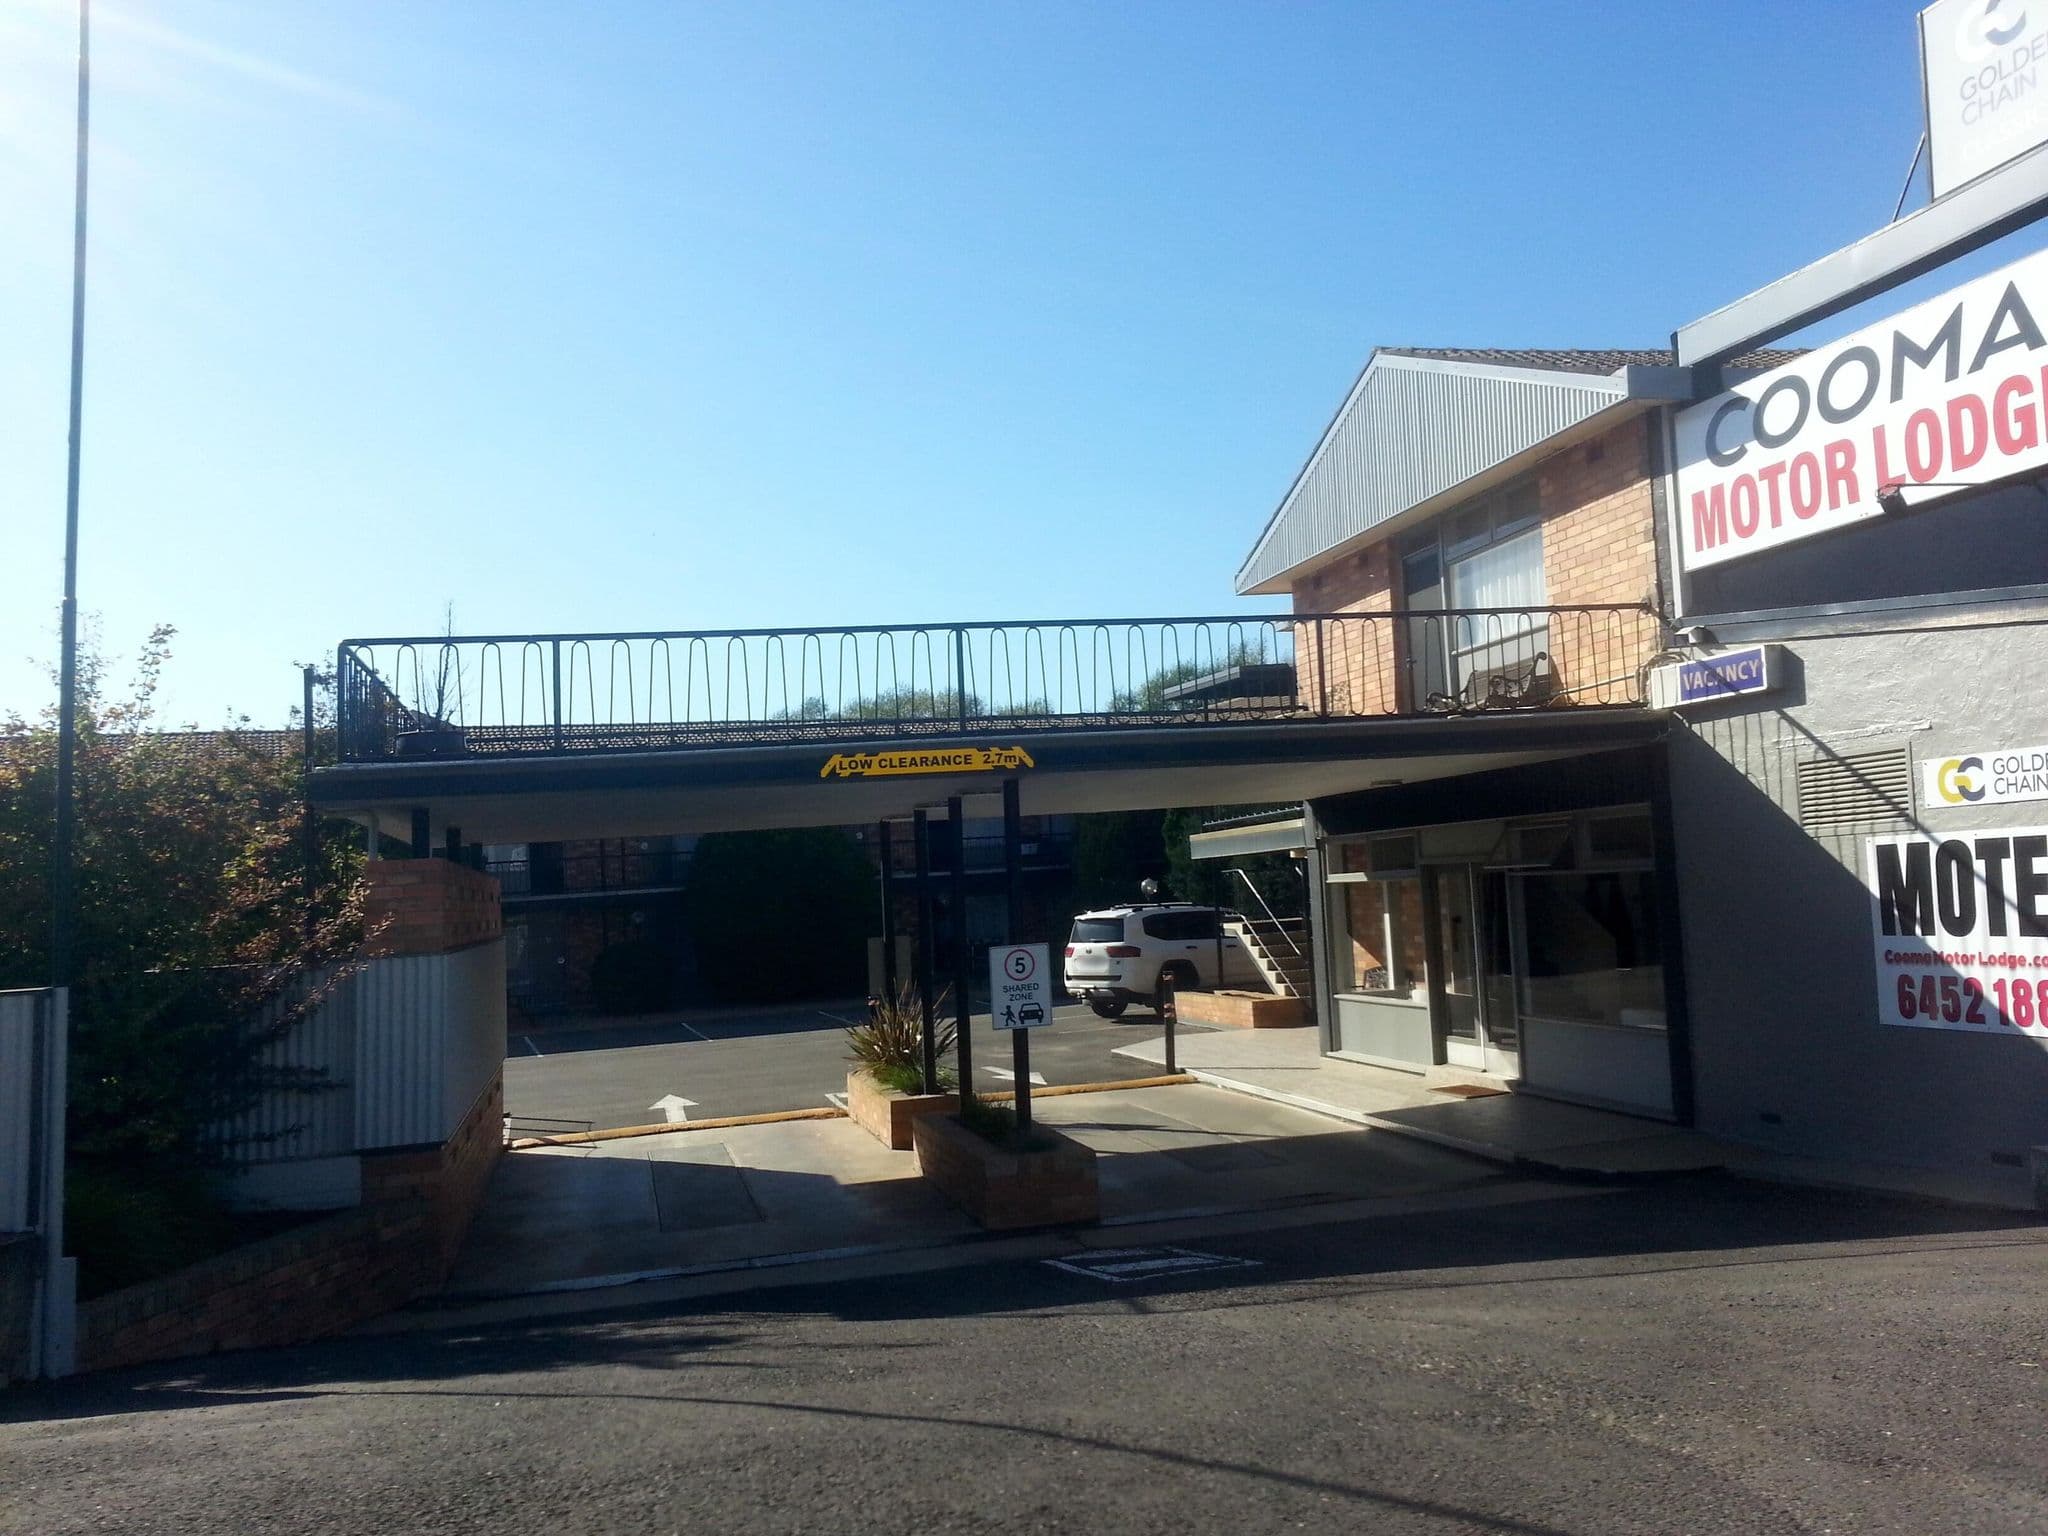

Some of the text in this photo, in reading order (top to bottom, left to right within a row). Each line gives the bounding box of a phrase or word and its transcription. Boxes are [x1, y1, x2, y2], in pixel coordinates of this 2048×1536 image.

[1959, 31, 2048, 102] GOLDE
[1961, 66, 2038, 126] CHAIN
[1704, 280, 2048, 468] COOMA
[1691, 364, 2048, 553] MOTOR LODG
[1684, 659, 1760, 690] VACANCY
[838, 752, 1018, 771] LOW CLEARANCE 2.7m
[1992, 752, 2048, 775] GOLD
[1994, 774, 2048, 795] CHAIN
[1876, 835, 2048, 937] MOTE
[1015, 957, 1026, 974] 5
[1002, 982, 1040, 993] SHARED
[1009, 992, 1033, 1002] ZONE
[1897, 973, 1986, 1025] 6452
